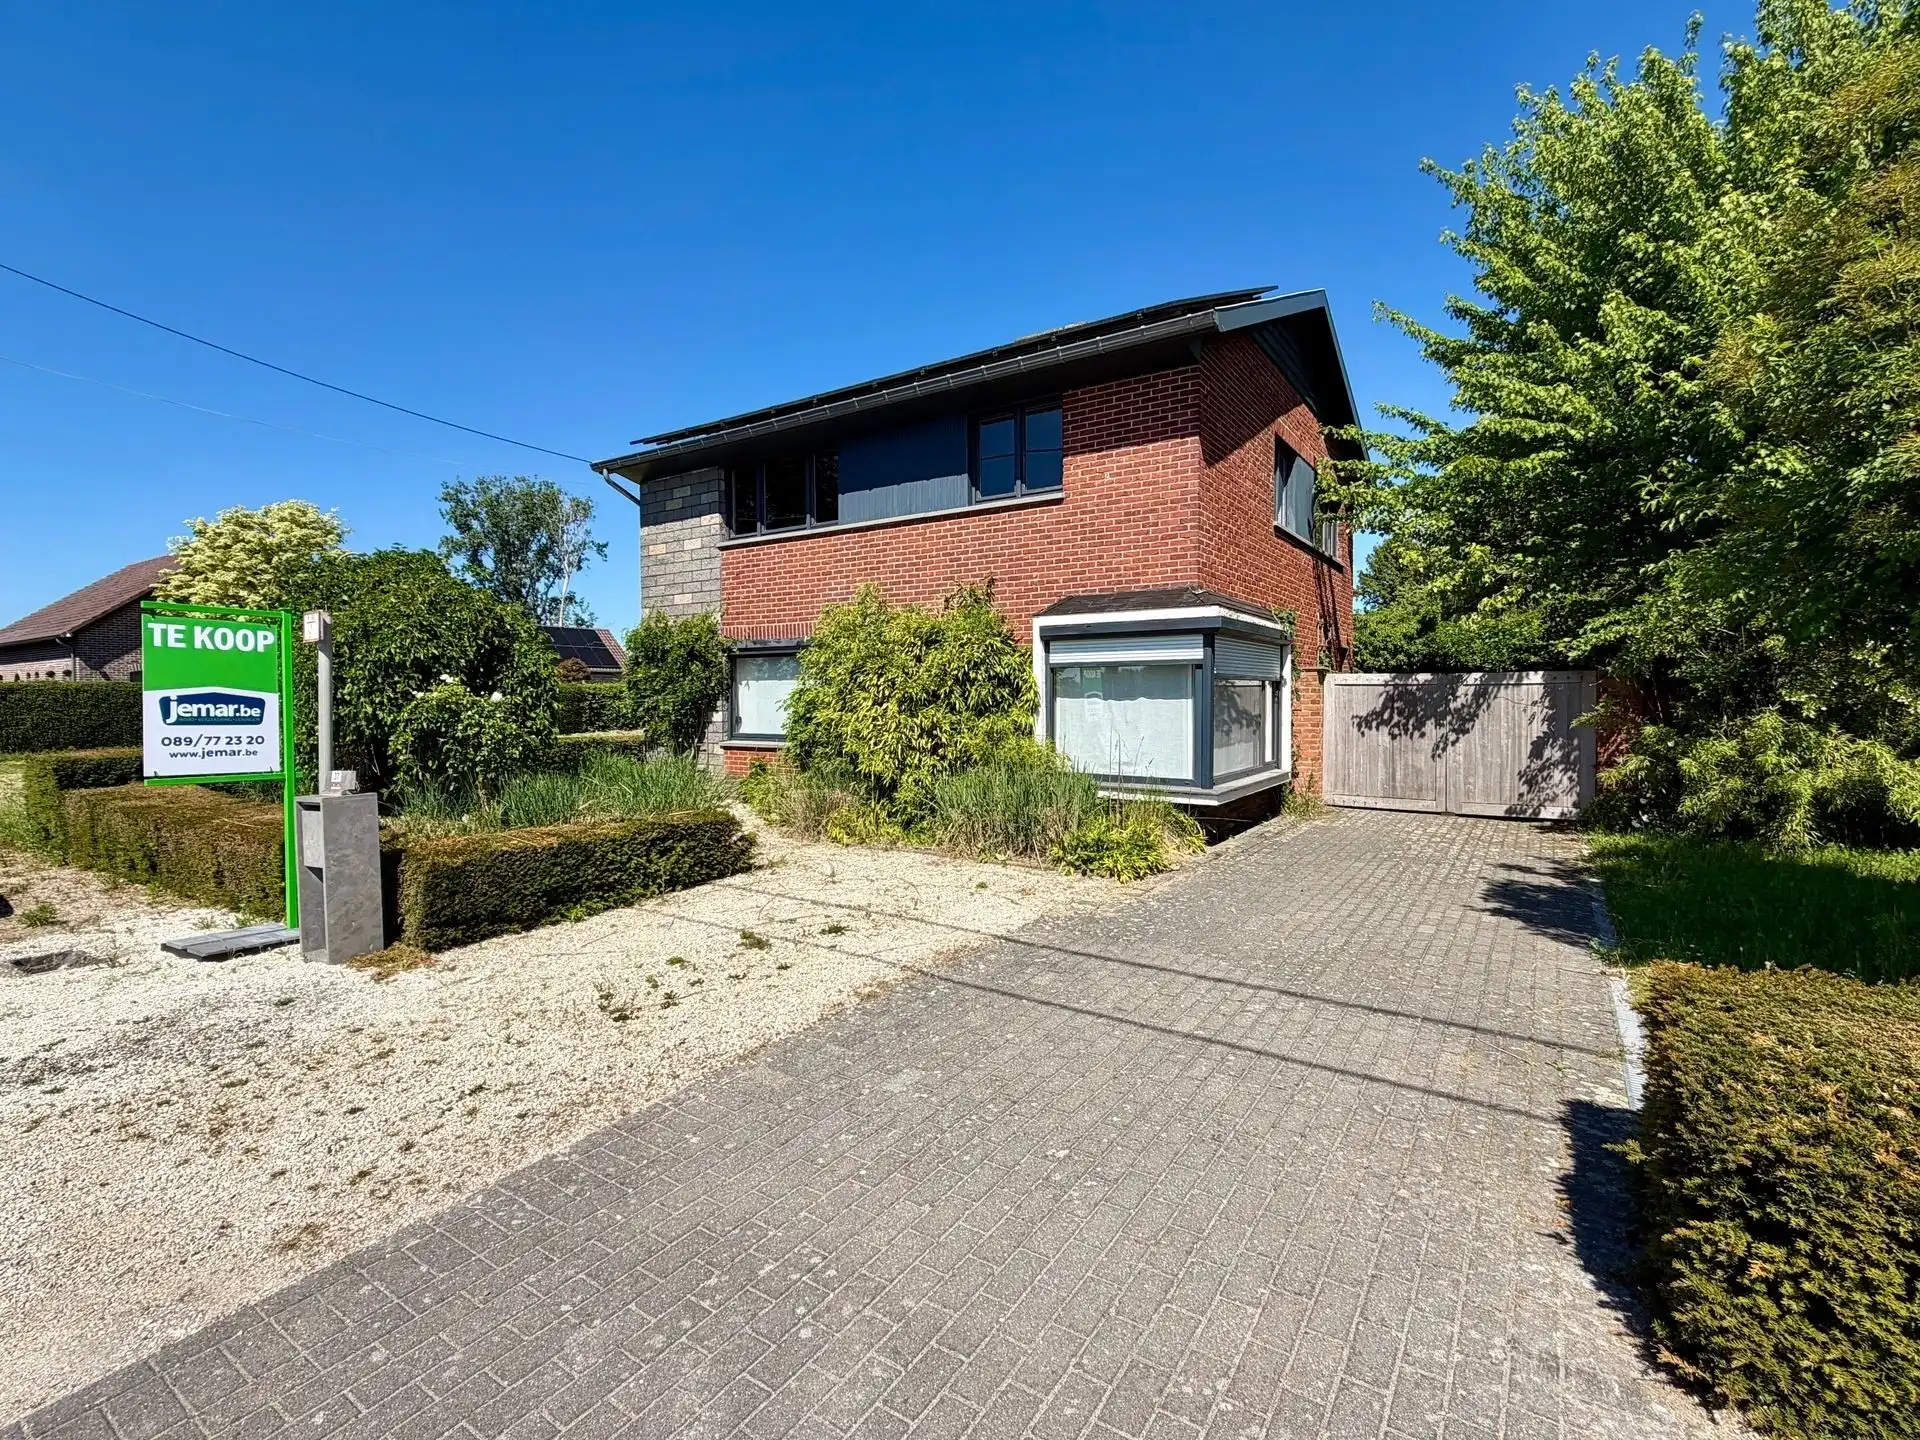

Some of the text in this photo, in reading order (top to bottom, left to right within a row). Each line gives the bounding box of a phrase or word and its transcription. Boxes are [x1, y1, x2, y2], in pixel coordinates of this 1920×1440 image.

[147, 622, 187, 648] TE
[193, 625, 275, 652] KOOP
[165, 695, 261, 724] jemar.be
[161, 734, 265, 747] 089/77 23 20
[169, 747, 258, 759] www.jemar.be
